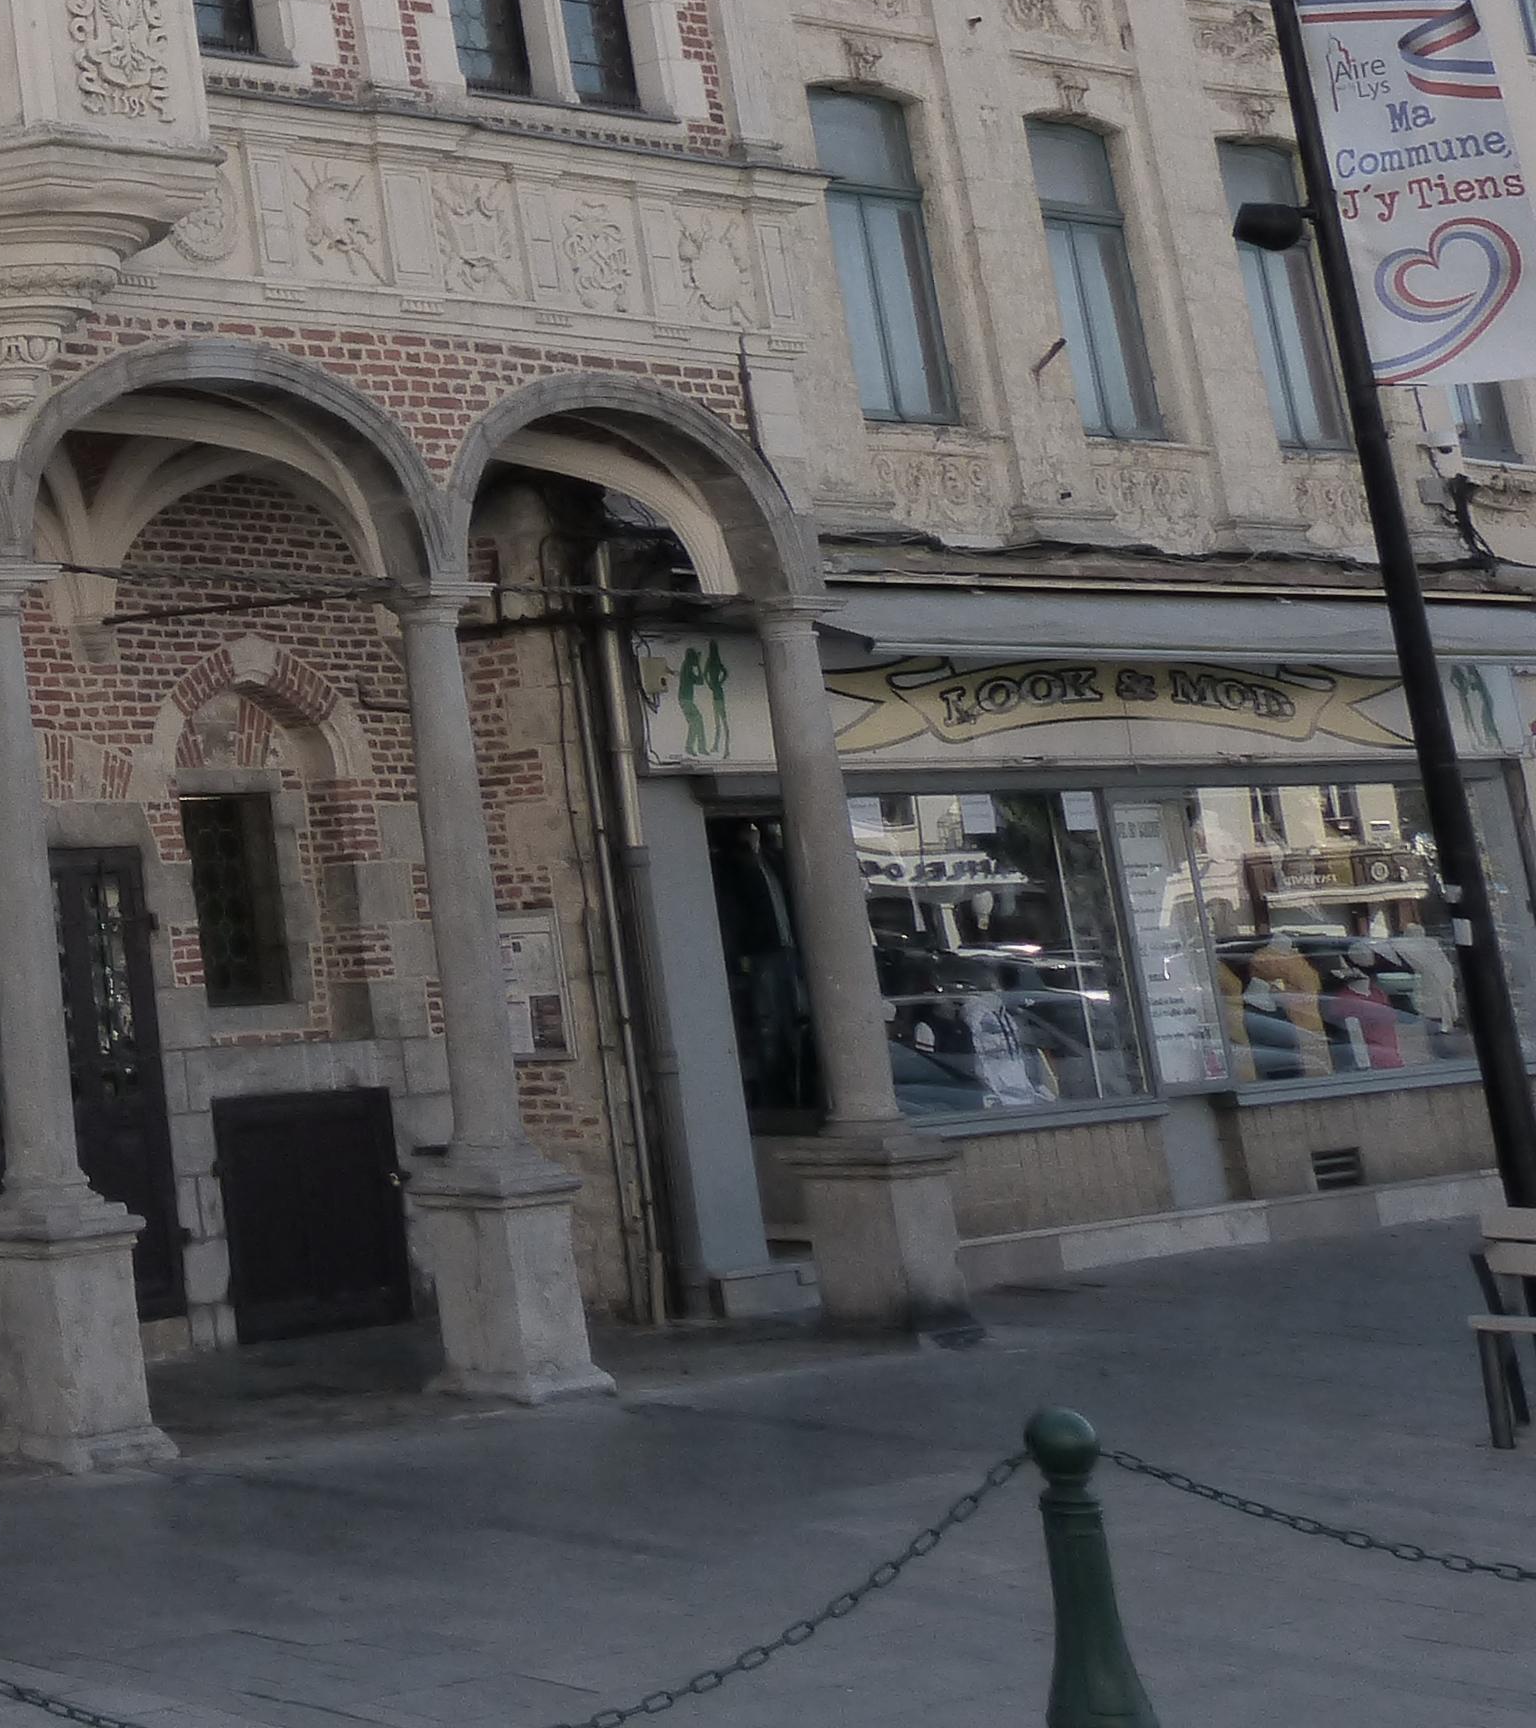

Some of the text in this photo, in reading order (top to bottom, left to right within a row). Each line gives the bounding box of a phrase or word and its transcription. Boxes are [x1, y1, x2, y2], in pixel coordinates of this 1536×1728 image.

[1335, 58, 1386, 83] Aire
[1357, 79, 1391, 100] Lys
[1386, 101, 1436, 133] Ma
[1336, 130, 1512, 179] Commune,
[1342, 174, 1526, 222] J'y Tiens
[939, 669, 1103, 727] LOOK
[1115, 670, 1158, 702] &
